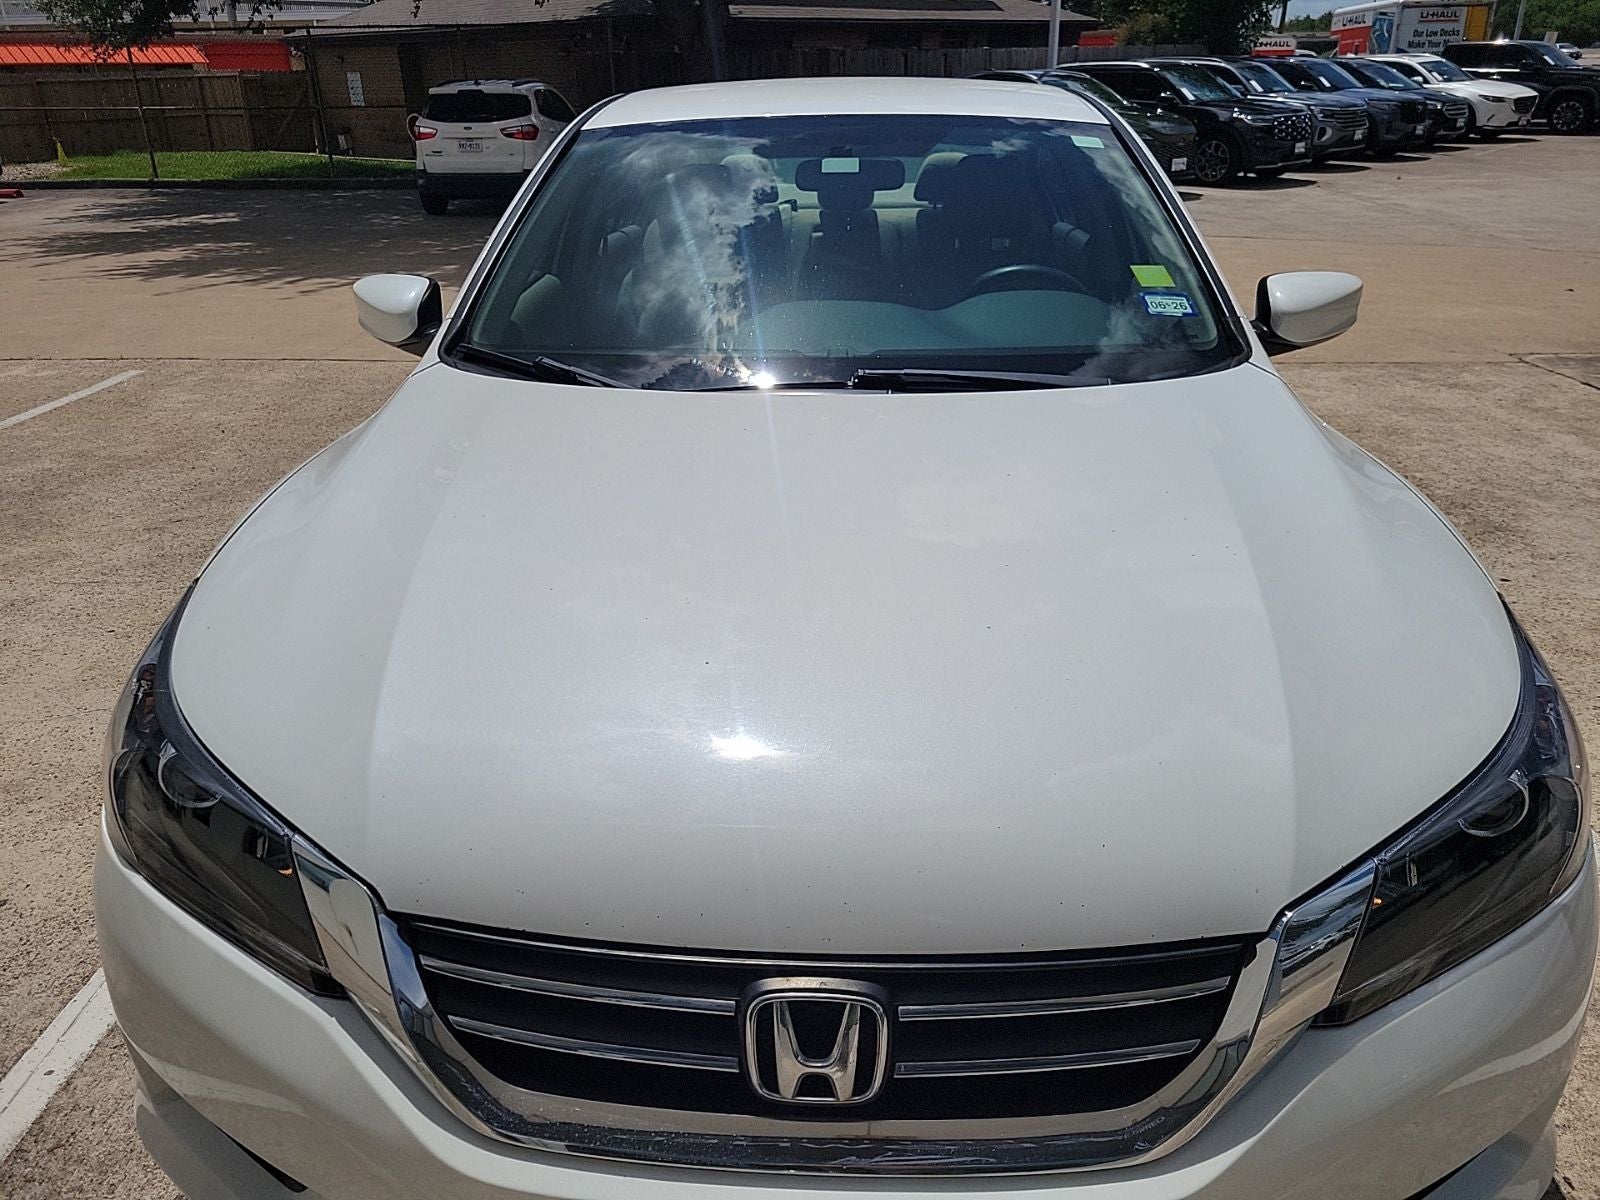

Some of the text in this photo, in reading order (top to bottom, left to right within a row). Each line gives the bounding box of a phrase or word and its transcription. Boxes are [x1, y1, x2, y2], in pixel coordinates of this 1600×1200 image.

[1420, 10, 1459, 19] U-HAUL
[1342, 14, 1367, 27] U-HAUL
[1412, 28, 1460, 38] Our Low Decks
[1407, 40, 1426, 49] Make
[1427, 40, 1442, 48] Your
